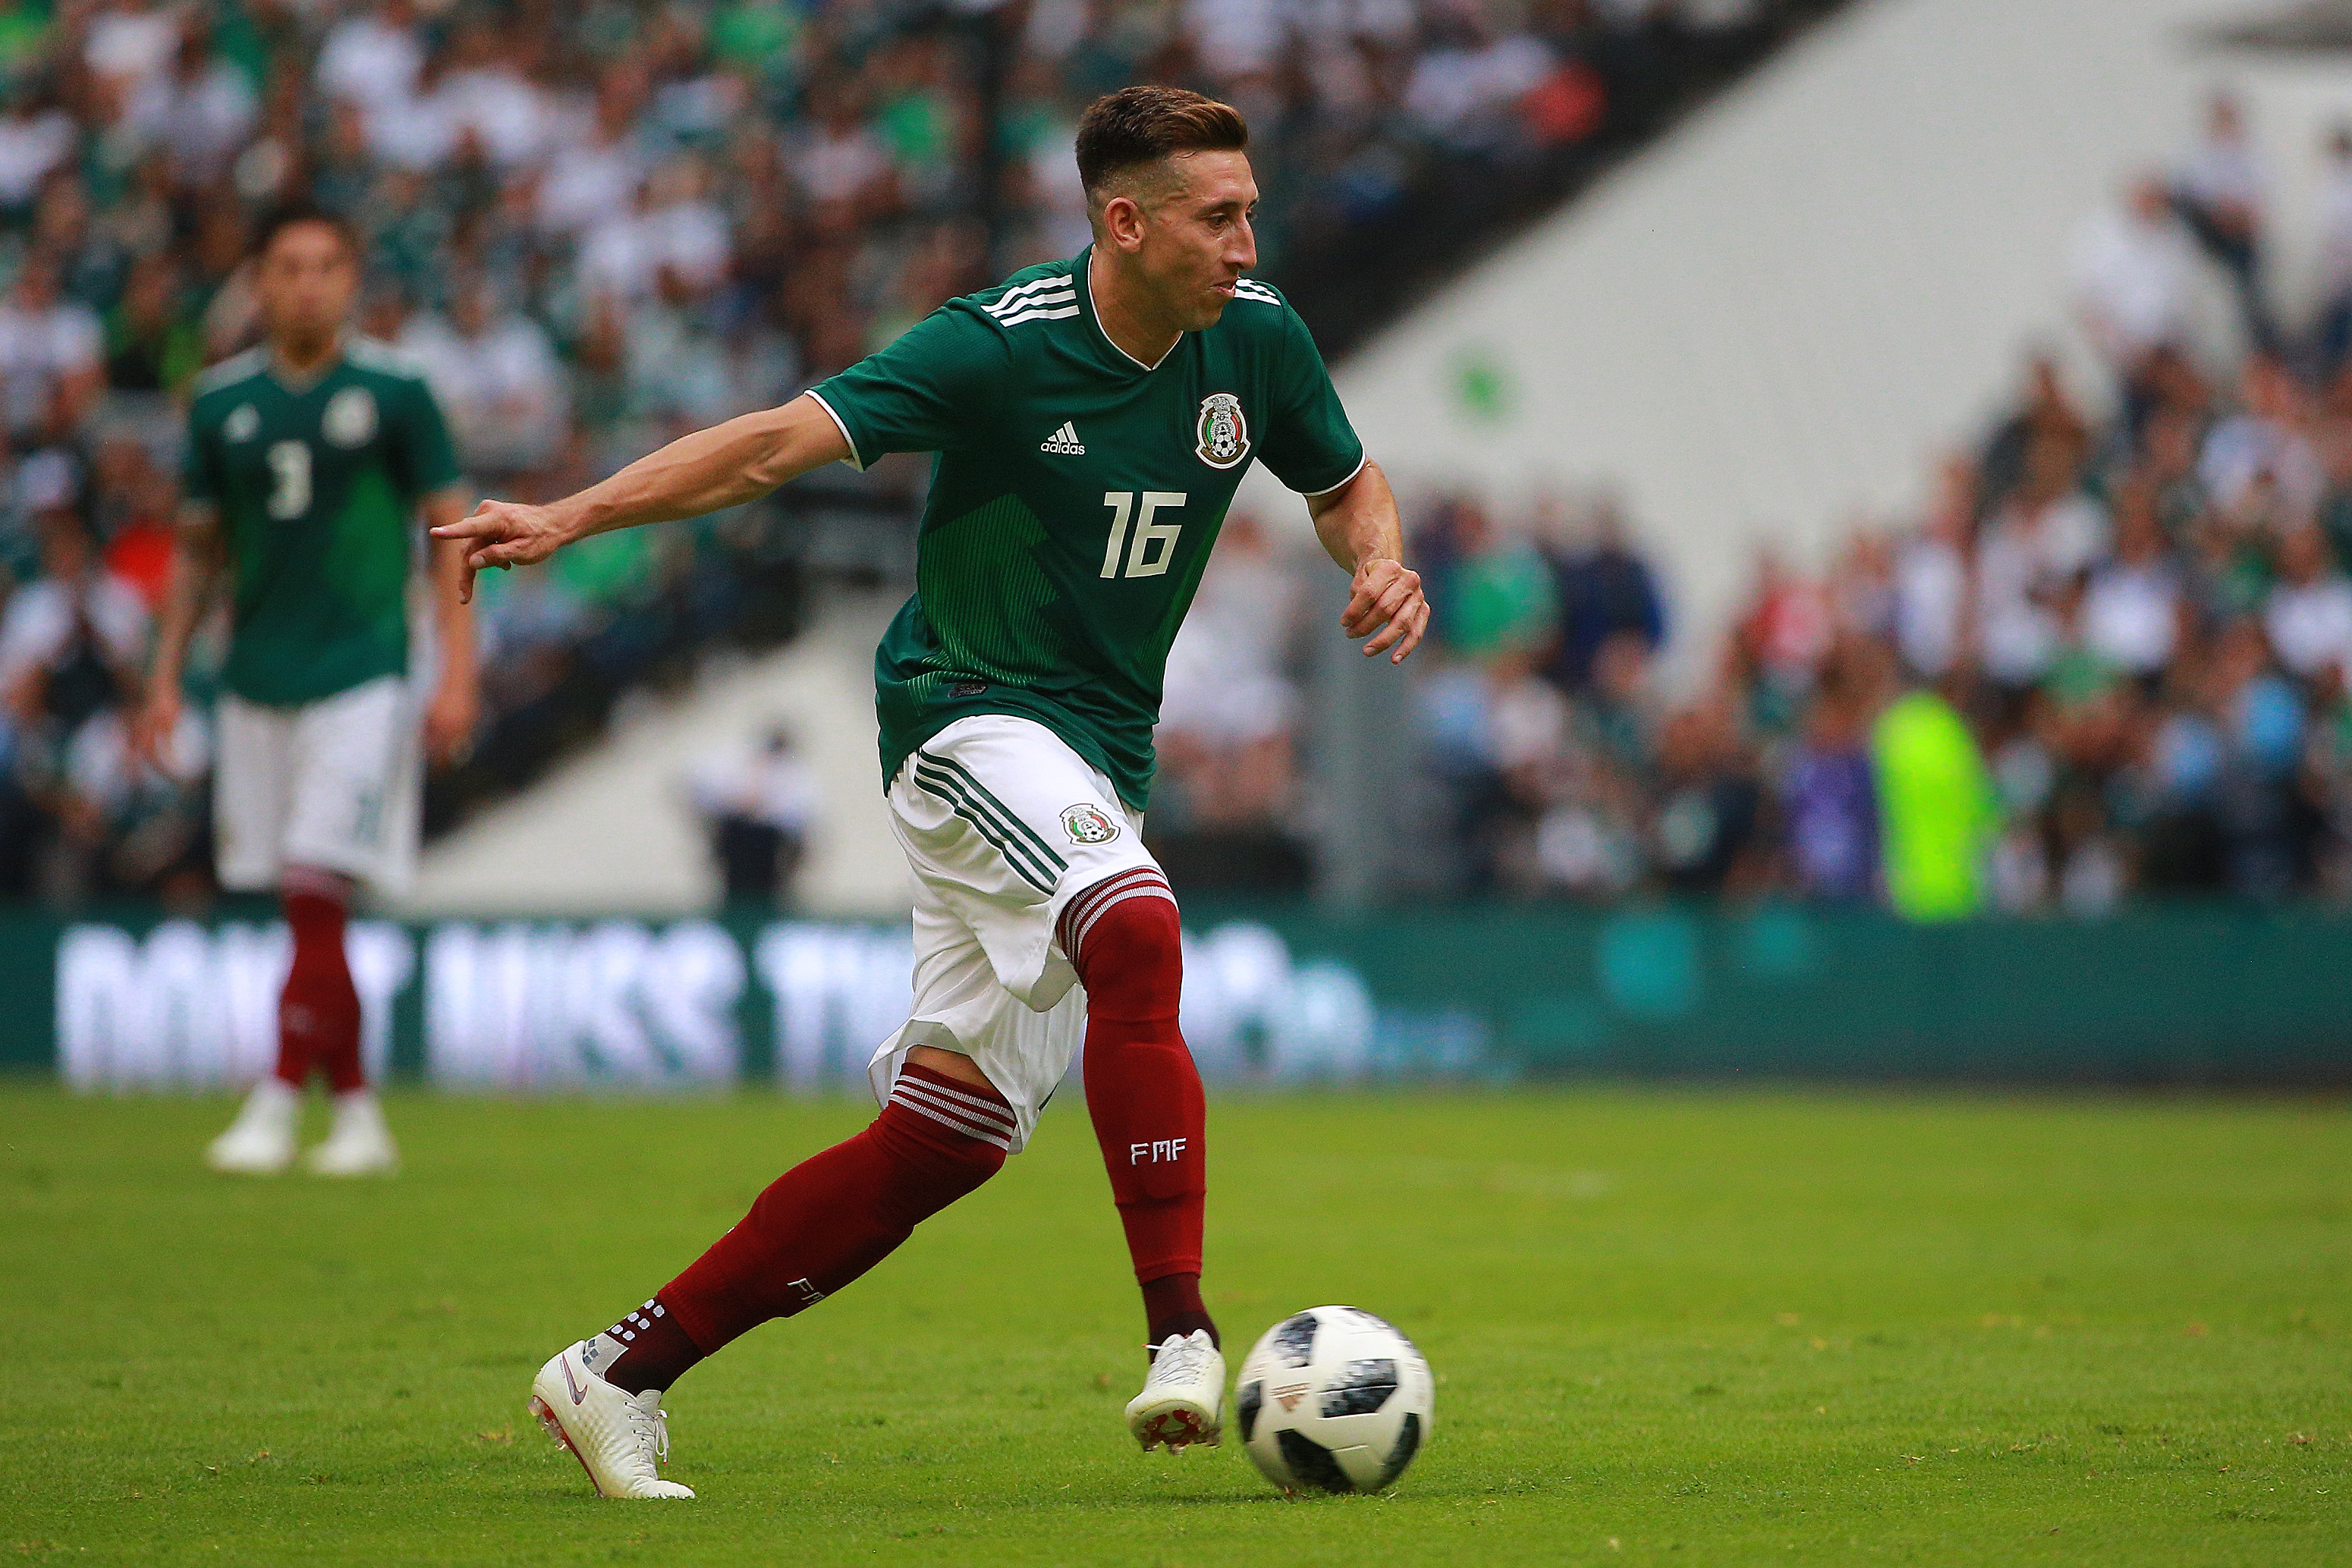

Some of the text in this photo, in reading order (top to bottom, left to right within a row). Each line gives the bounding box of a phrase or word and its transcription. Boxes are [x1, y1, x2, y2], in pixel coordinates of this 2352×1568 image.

[1040, 441, 1086, 455] adidas
[266, 438, 313, 521] 3
[1099, 492, 1187, 579] 16
[1130, 1137, 1187, 1166] FMF
